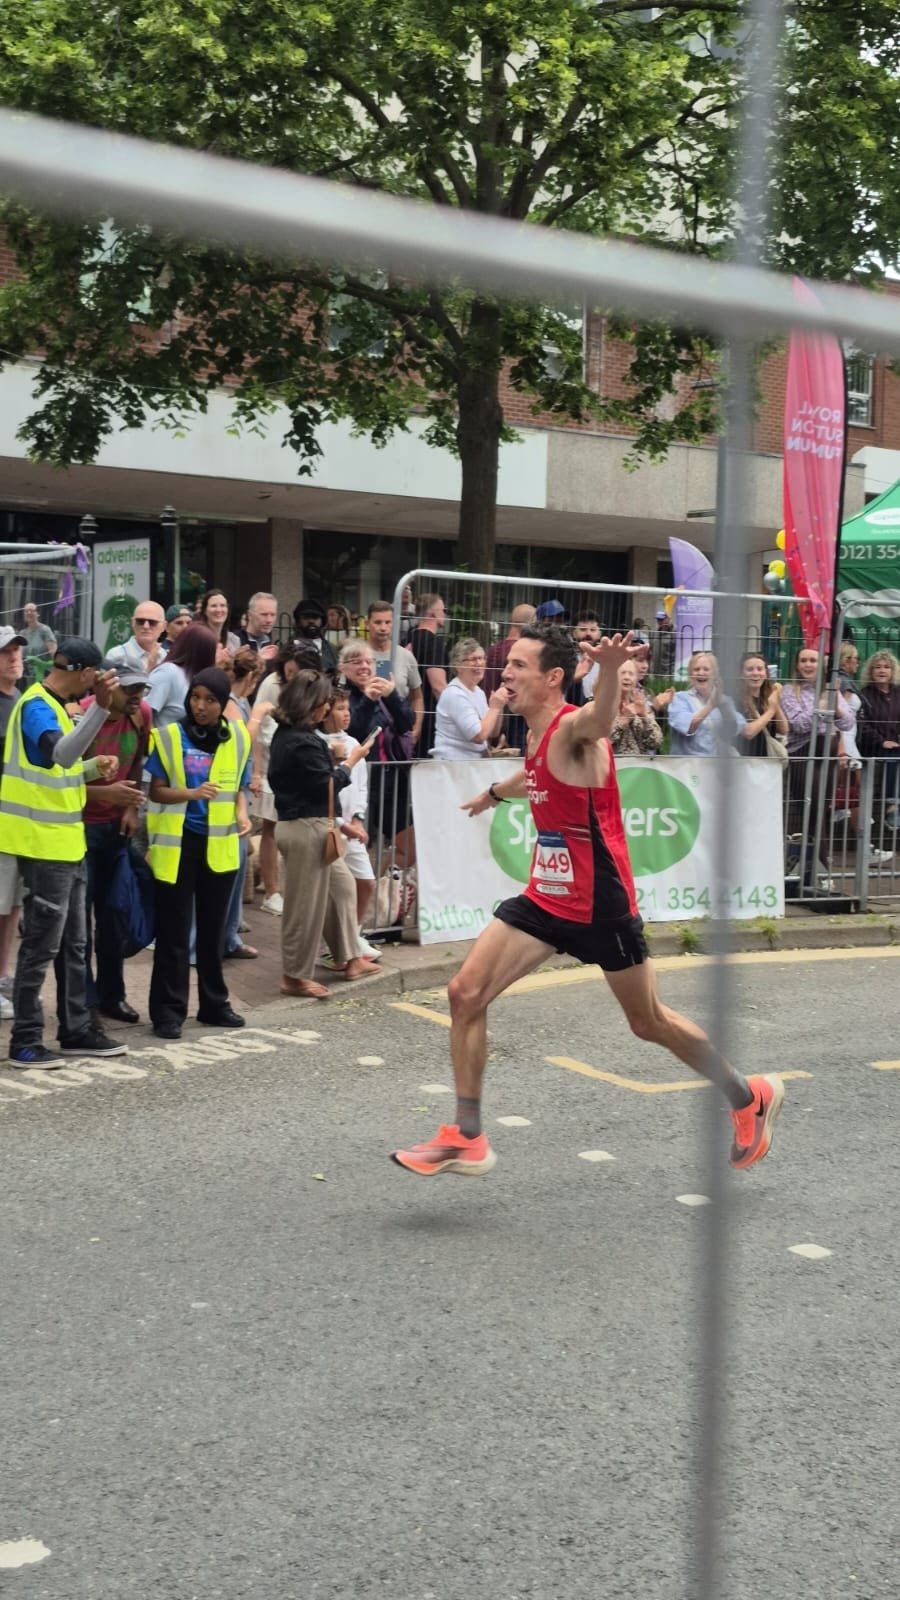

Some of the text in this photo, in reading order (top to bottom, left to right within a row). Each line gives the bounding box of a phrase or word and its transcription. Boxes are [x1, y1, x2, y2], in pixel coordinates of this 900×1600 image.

[97, 545, 148, 563] advertise
[537, 852, 570, 873] 449
[419, 903, 485, 933] Sutton
[667, 886, 711, 911] 354
